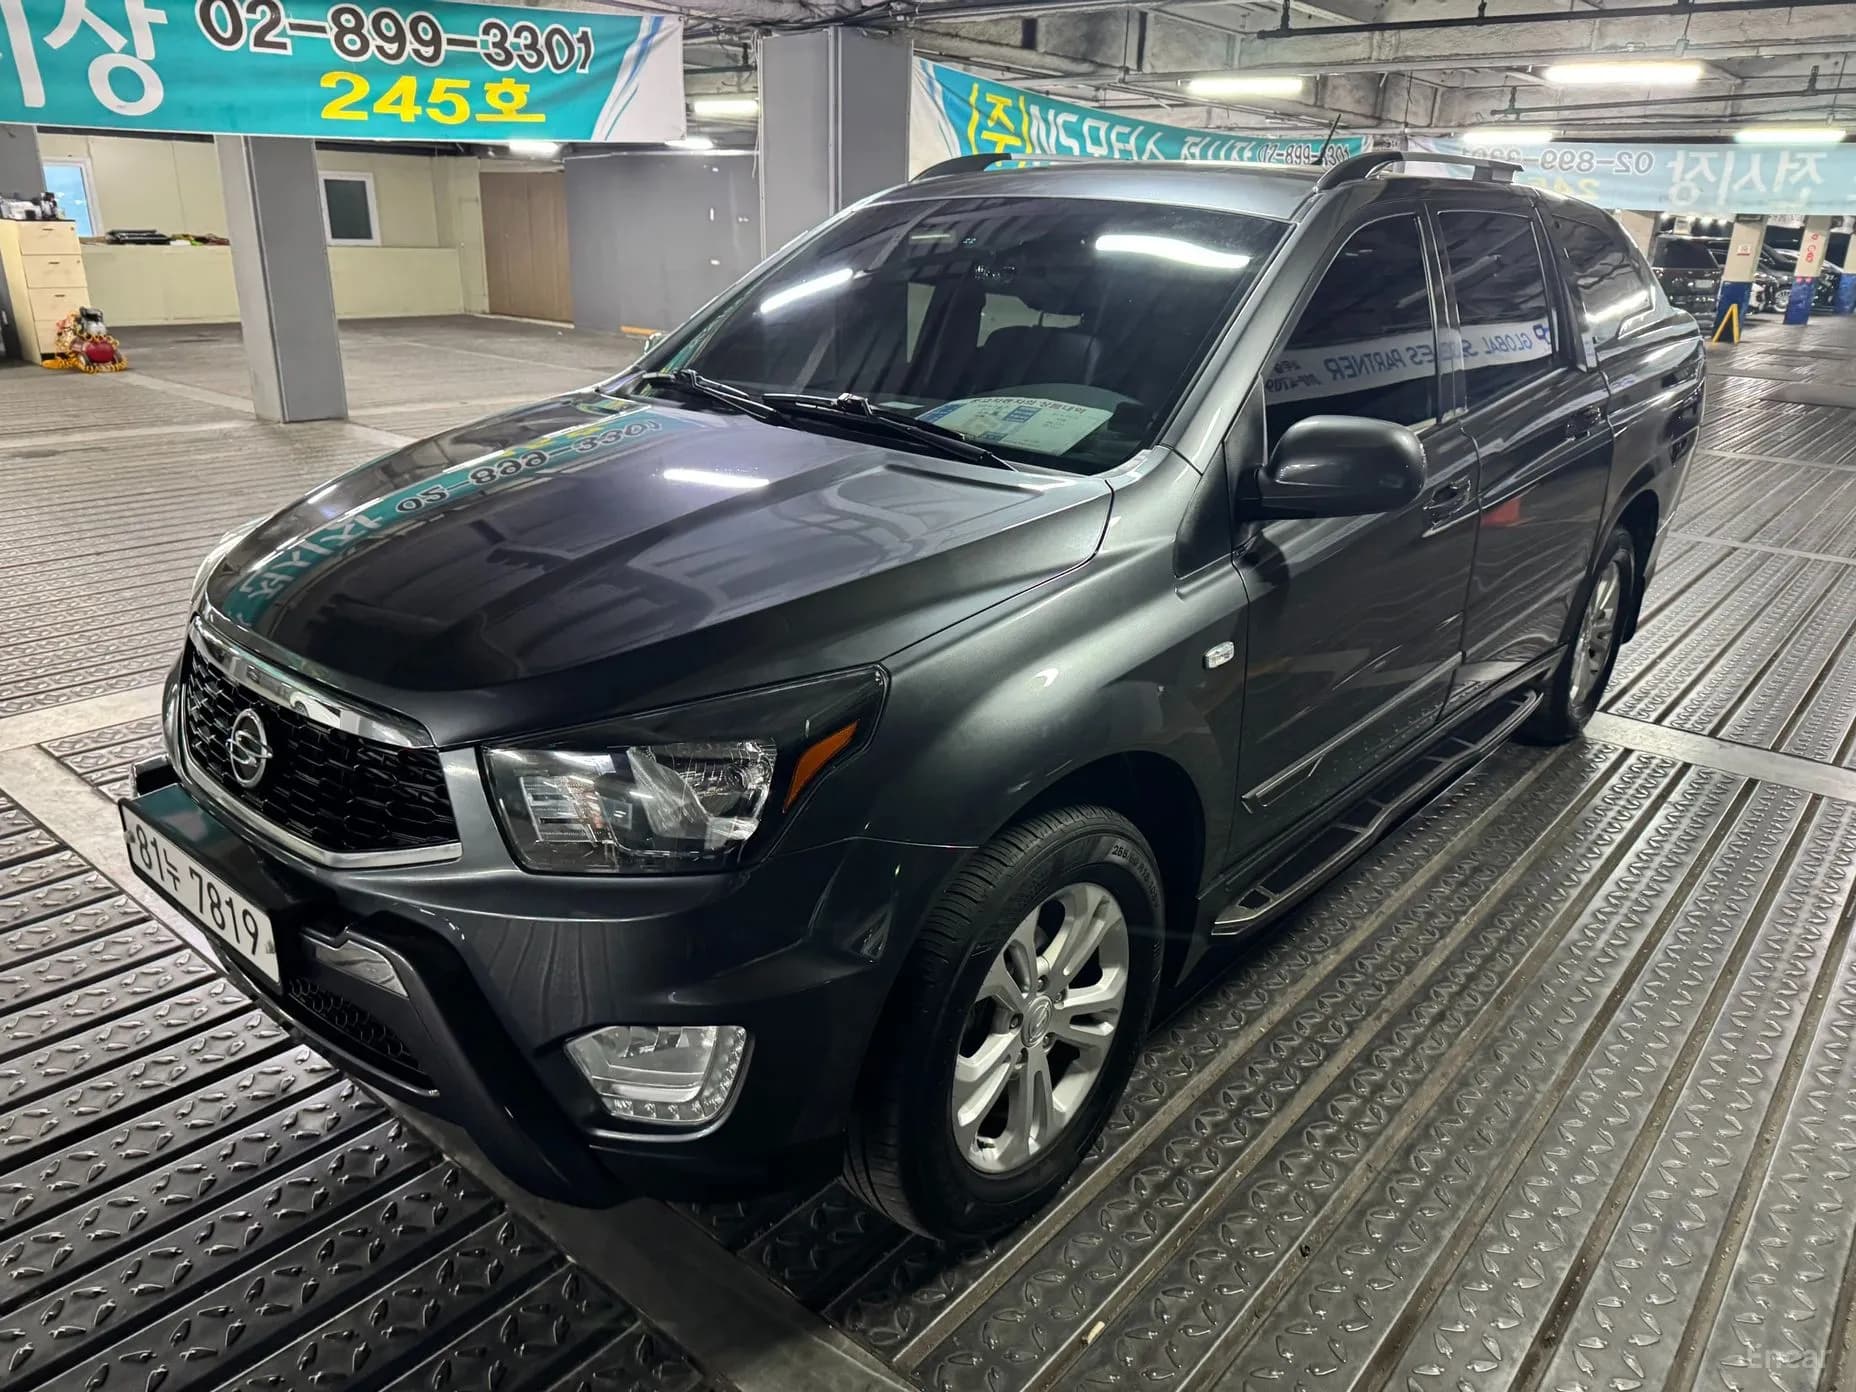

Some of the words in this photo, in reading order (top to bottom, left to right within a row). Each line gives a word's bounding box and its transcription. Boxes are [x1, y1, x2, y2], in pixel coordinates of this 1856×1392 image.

[195, 0, 593, 74] 02-899-3301
[319, 71, 546, 123] 245호
[136, 824, 181, 891] 81누
[189, 866, 259, 955] 7819
